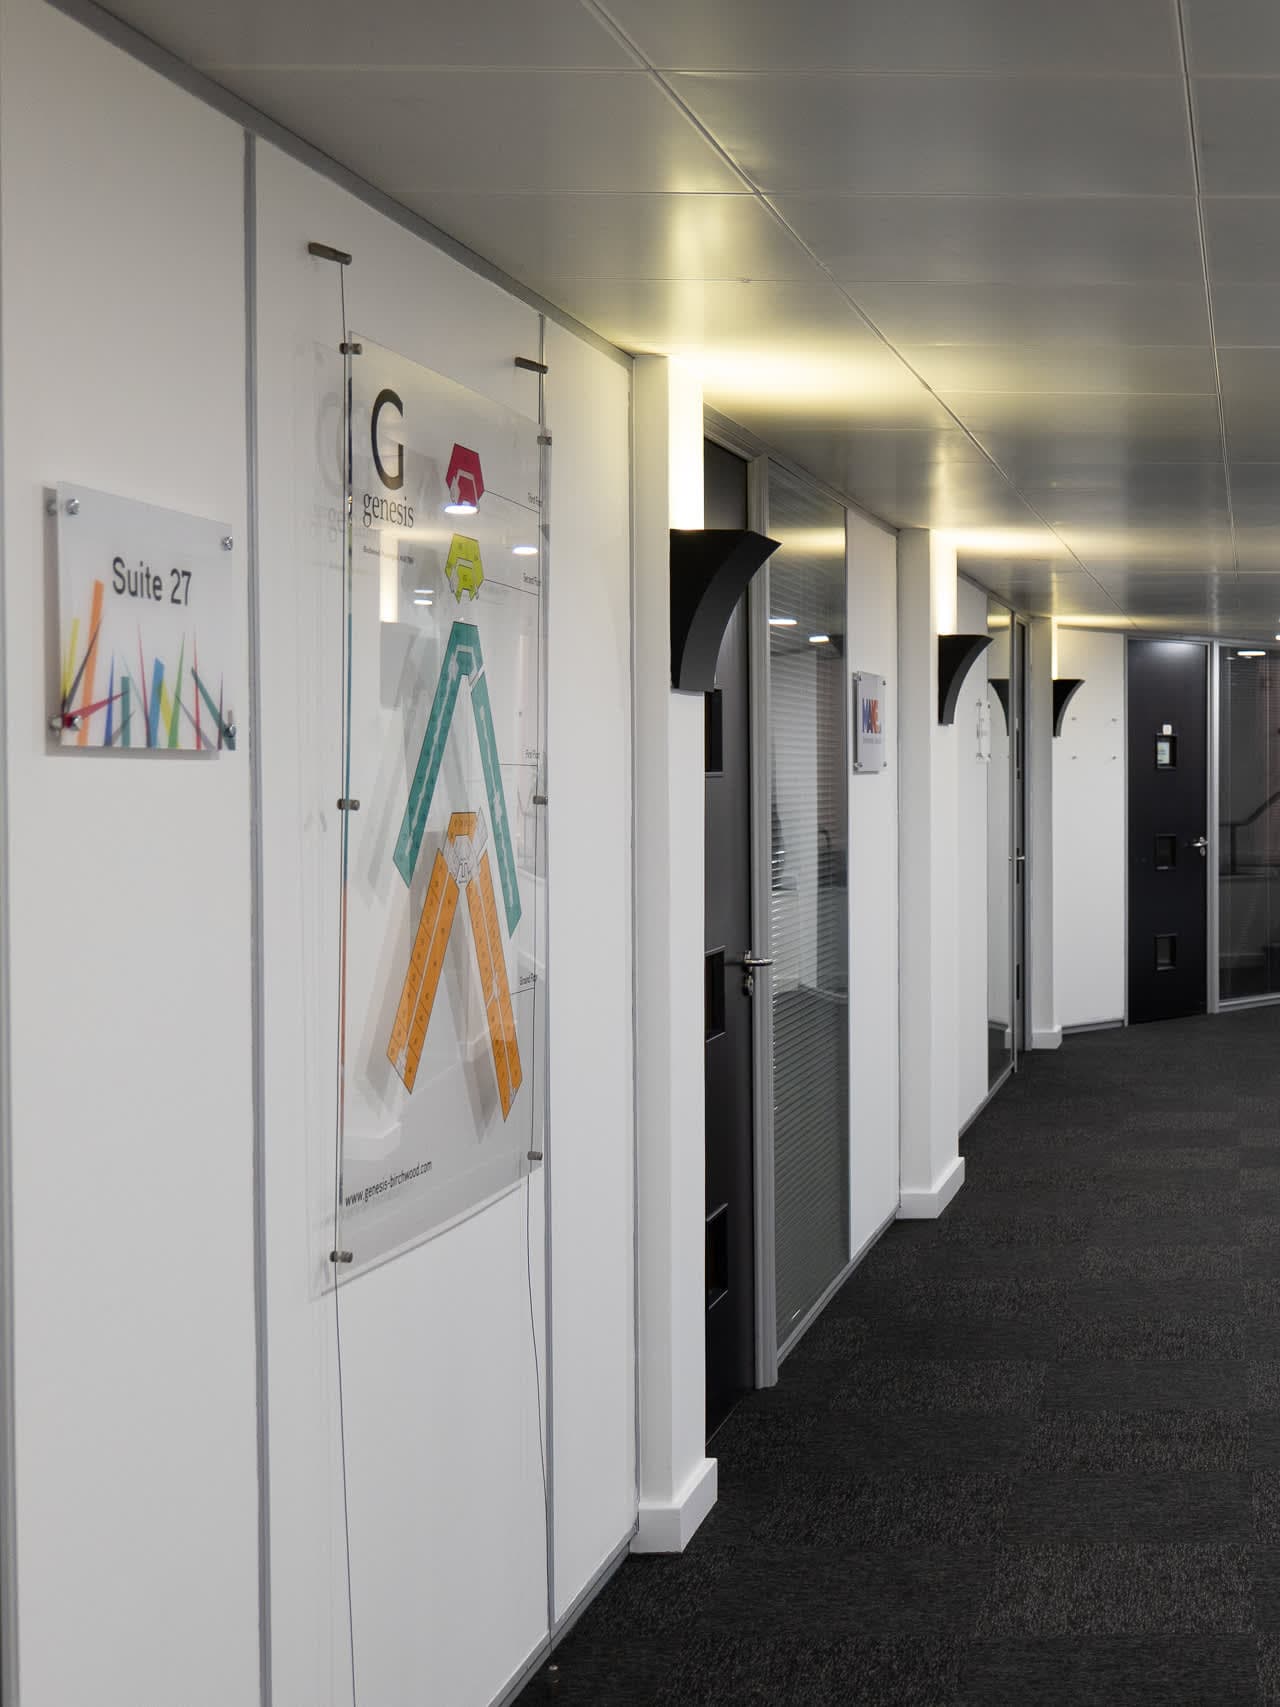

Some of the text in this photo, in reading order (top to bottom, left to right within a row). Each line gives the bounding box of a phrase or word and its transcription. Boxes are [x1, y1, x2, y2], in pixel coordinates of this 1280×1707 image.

[371, 388, 405, 490] G
[362, 493, 415, 529] genesis
[112, 556, 193, 607] Suite 27
[345, 1160, 433, 1207] www.genesis-birchwood.com
